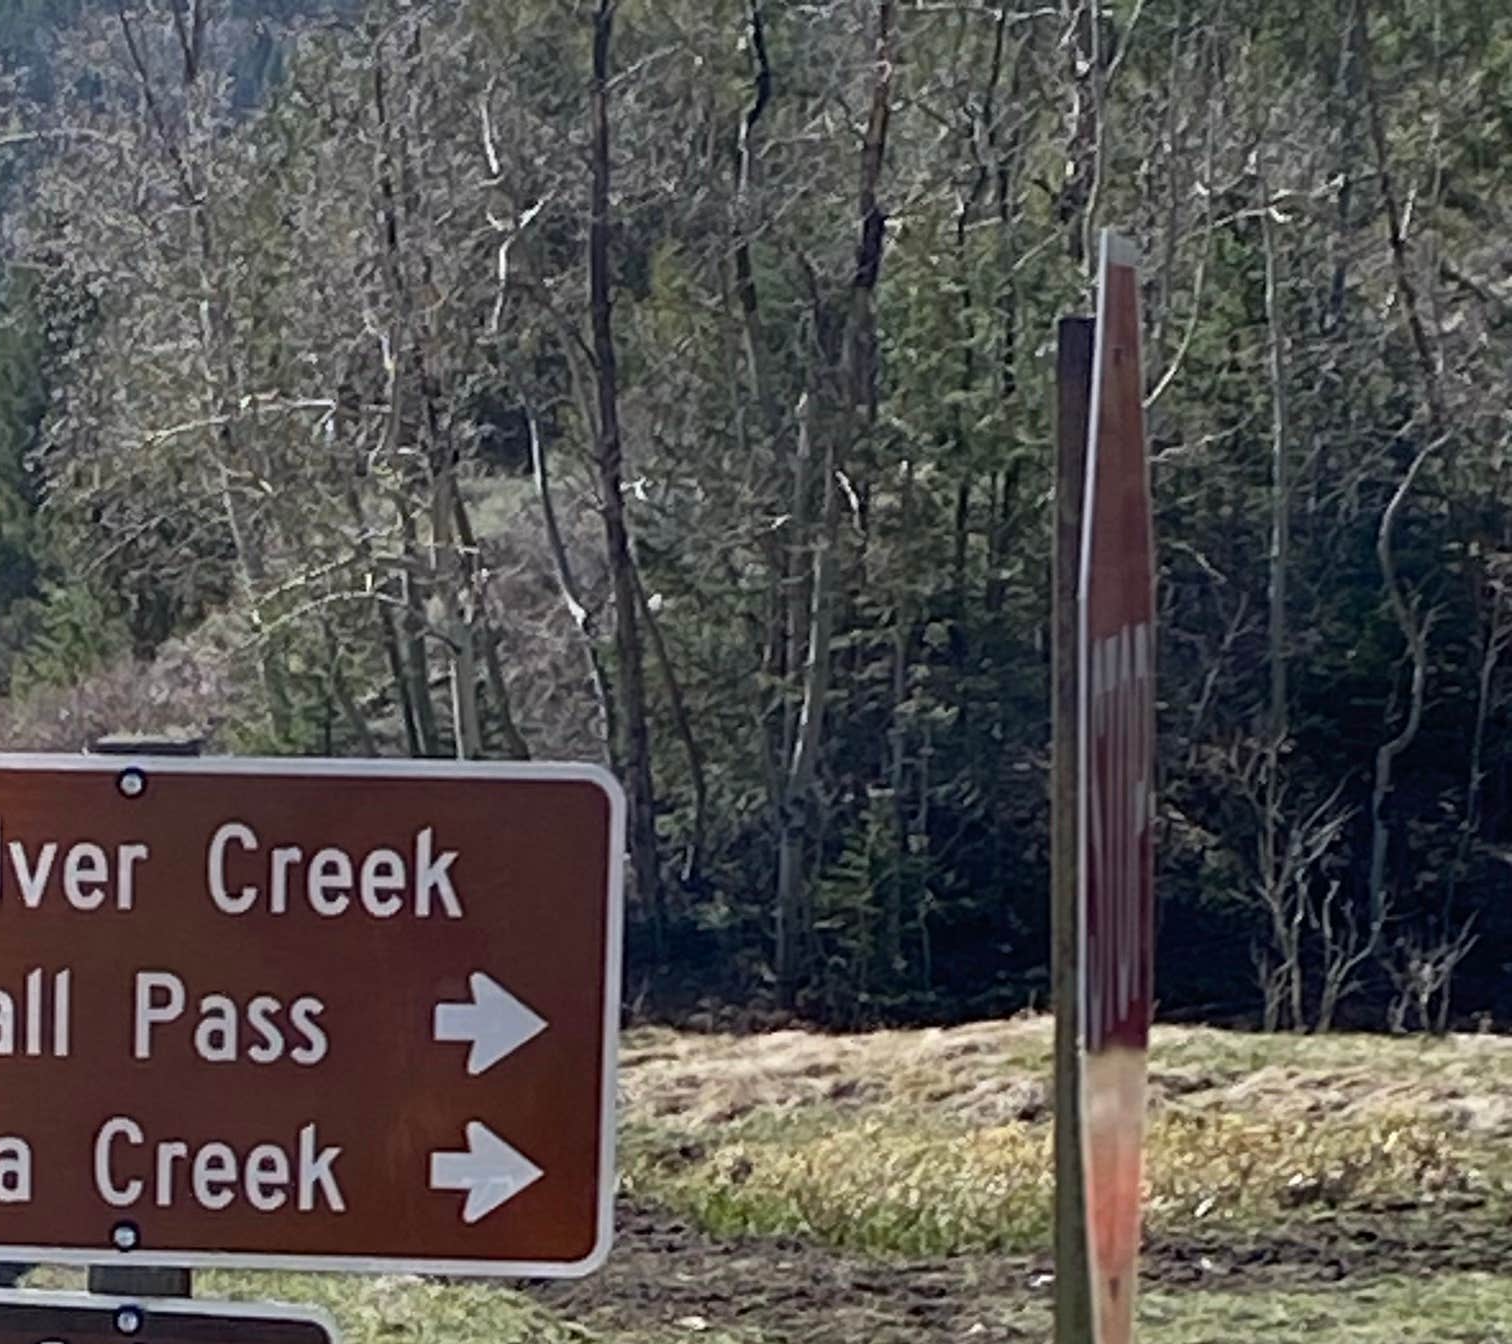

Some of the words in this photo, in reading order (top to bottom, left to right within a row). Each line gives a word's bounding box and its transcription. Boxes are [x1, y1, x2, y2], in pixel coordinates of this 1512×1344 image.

[207, 822, 463, 918] Creek
[134, 971, 328, 1064] Pass
[94, 1116, 346, 1212] Creek
